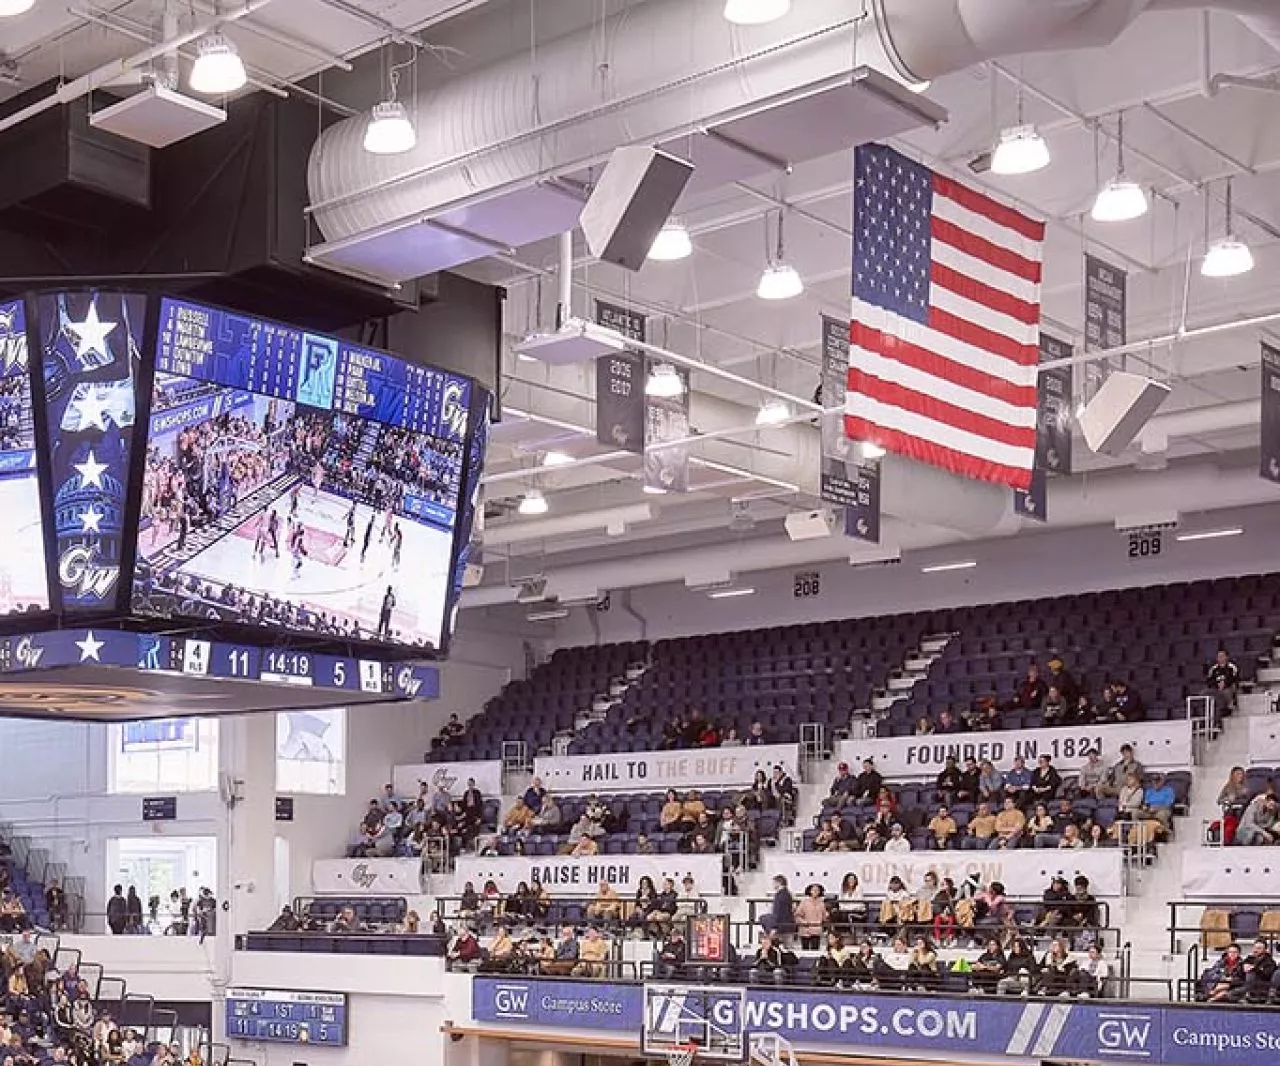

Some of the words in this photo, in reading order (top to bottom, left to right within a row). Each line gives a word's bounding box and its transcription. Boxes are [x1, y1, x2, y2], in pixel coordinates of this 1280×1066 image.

[1128, 538, 1161, 557] 209
[59, 543, 121, 599] GW
[794, 579, 819, 597] 208
[17, 635, 43, 667] GW
[229, 650, 249, 676] 11
[269, 652, 309, 675] 14:19
[334, 661, 346, 686] 5
[398, 667, 422, 695] GW
[906, 741, 1004, 765] FOUNDED
[1014, 739, 1041, 761] IN
[1050, 736, 1105, 758] 1821
[583, 763, 620, 781] HAIL
[626, 761, 648, 780] TO
[656, 759, 693, 778] THE
[695, 757, 738, 775] BUFF
[531, 865, 582, 885] RAISE
[587, 865, 631, 885] HIGH
[275, 1003, 293, 1018] 1ST
[496, 986, 528, 1010] GW
[542, 995, 589, 1016] Campus
[591, 997, 622, 1015] Store
[320, 1024, 328, 1041] 5
[714, 1000, 977, 1040] GWSHOPS.COM
[1098, 1019, 1151, 1048] GW
[1173, 1027, 1251, 1052] Campus
